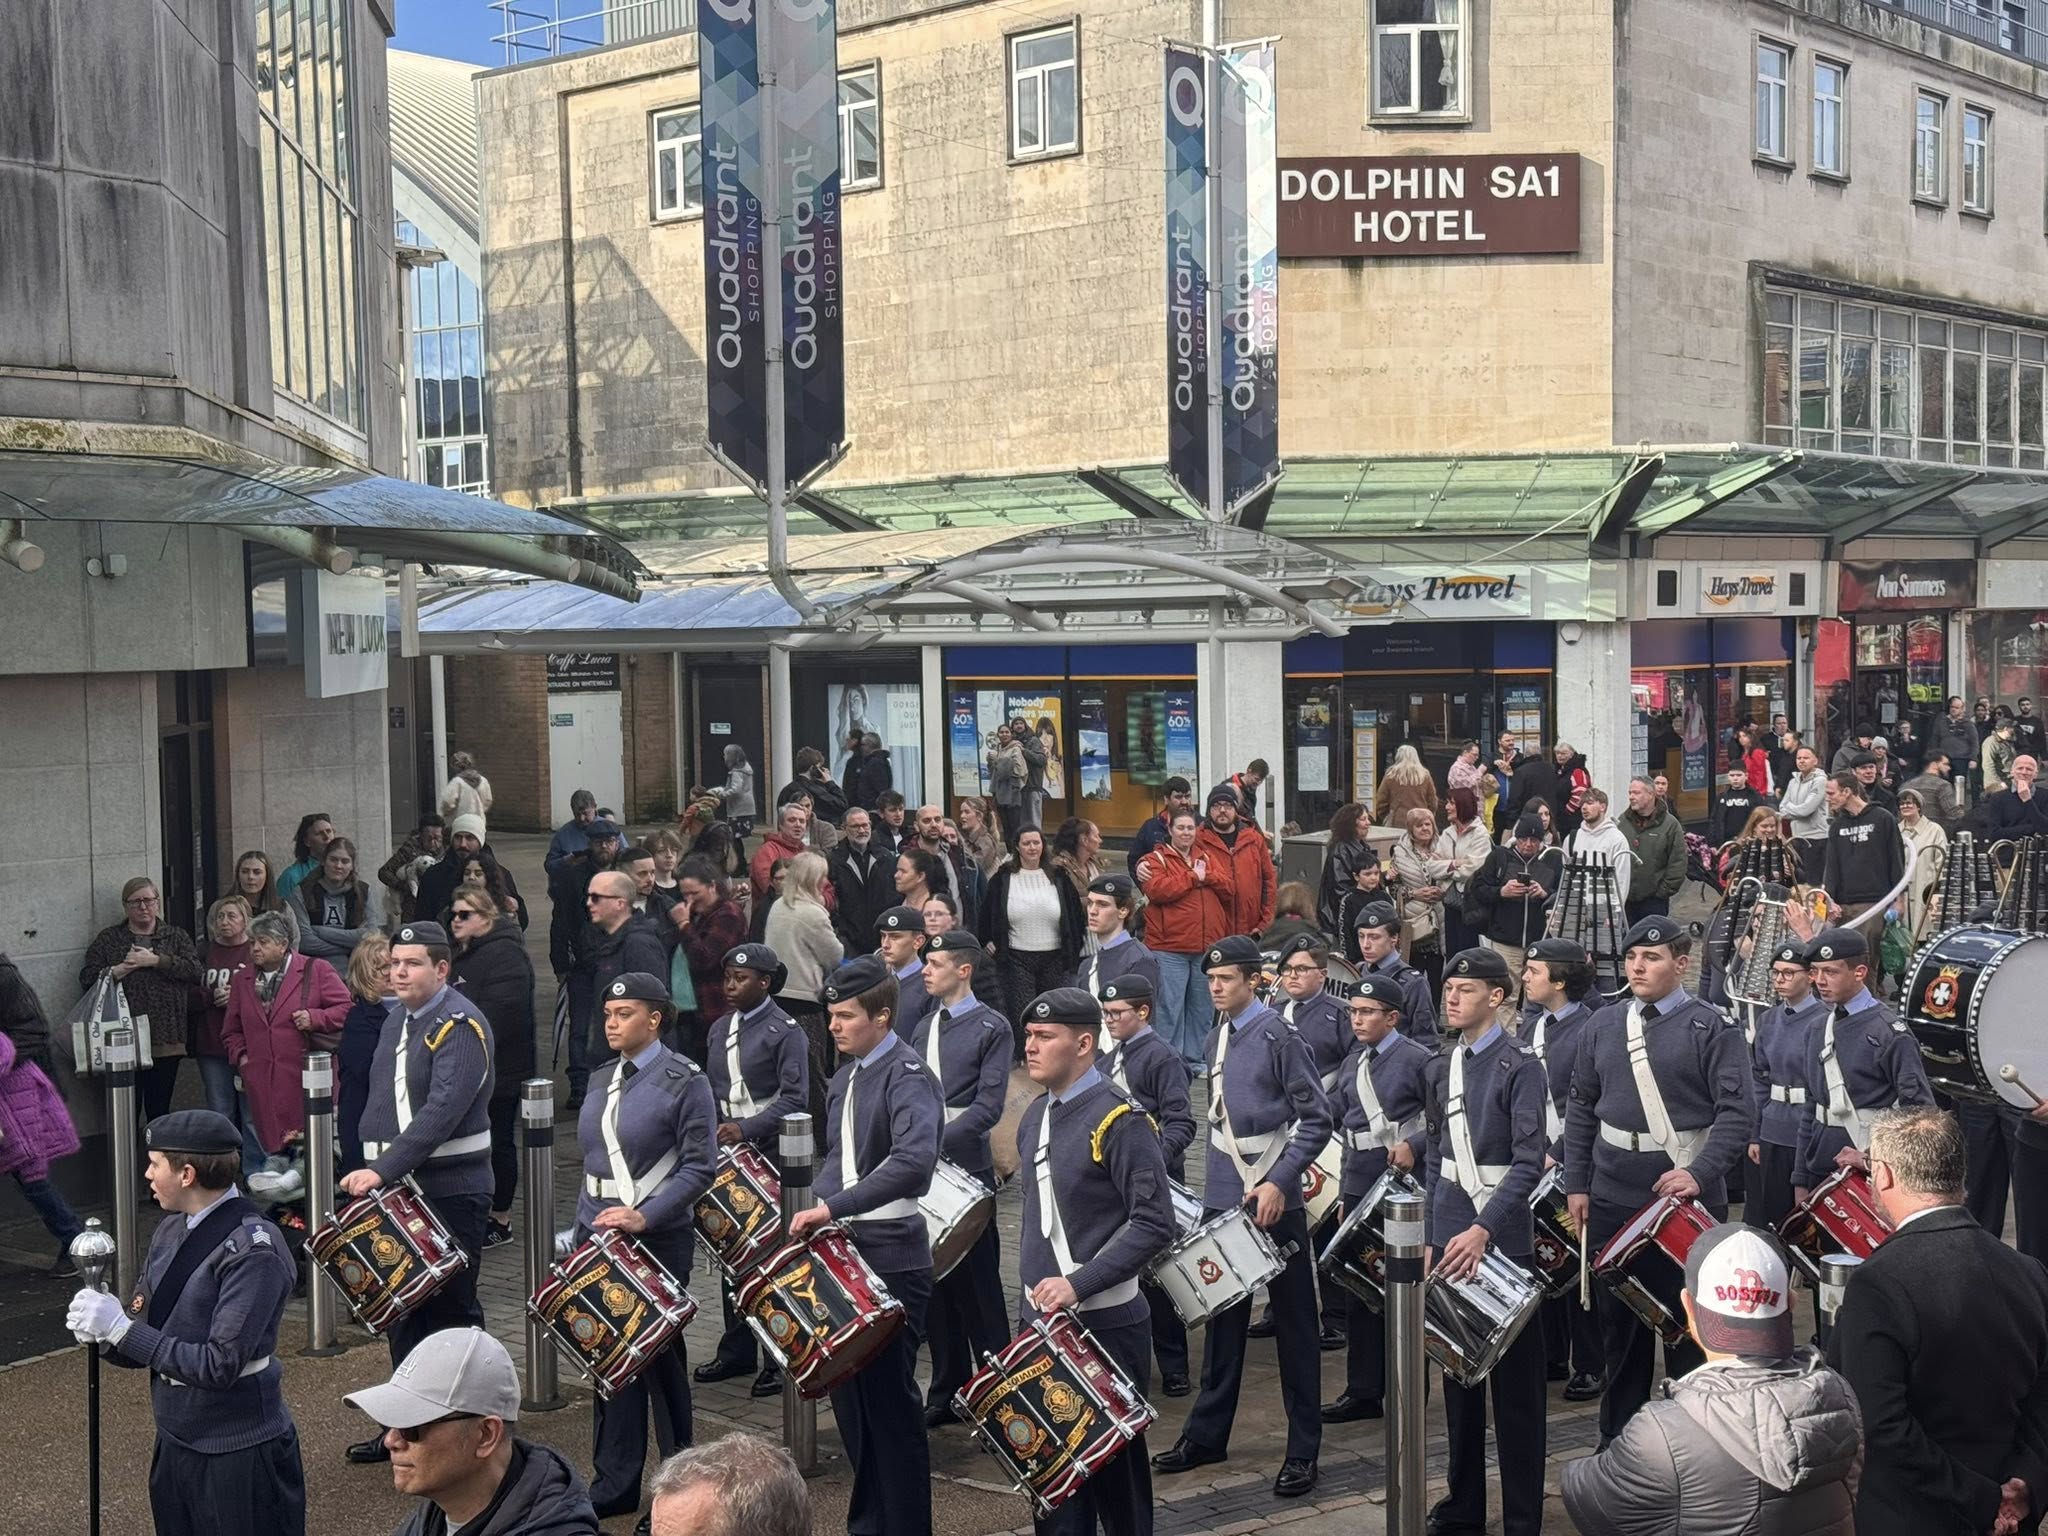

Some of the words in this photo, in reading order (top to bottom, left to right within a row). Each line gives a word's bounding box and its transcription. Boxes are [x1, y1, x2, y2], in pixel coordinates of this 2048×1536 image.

[1169, 66, 1203, 128] Q
[1281, 167, 1465, 202] DOLPHIN
[1490, 165, 1560, 199] SA1
[1354, 210, 1486, 243] HOTEL
[745, 197, 760, 323] SHOPPING
[822, 191, 837, 318] SHOPPING
[1194, 270, 1206, 373] SHOPPING
[1261, 264, 1274, 370] SHOPPING
[1422, 574, 1517, 601] Travel
[1711, 576, 1739, 601] Hays
[1740, 575, 1775, 596] Travel
[1876, 574, 1899, 598] Ann
[1899, 573, 1946, 598] Summers
[325, 613, 355, 655] NEW
[356, 614, 386, 654] LOOK
[1008, 697, 1046, 708] Nobody
[1037, 709, 1056, 718] you
[1168, 715, 1191, 727] 60%
[1725, 798, 1749, 807] NASA
[325, 906, 343, 926] A
[1714, 1284, 1782, 1308] BOSTON
